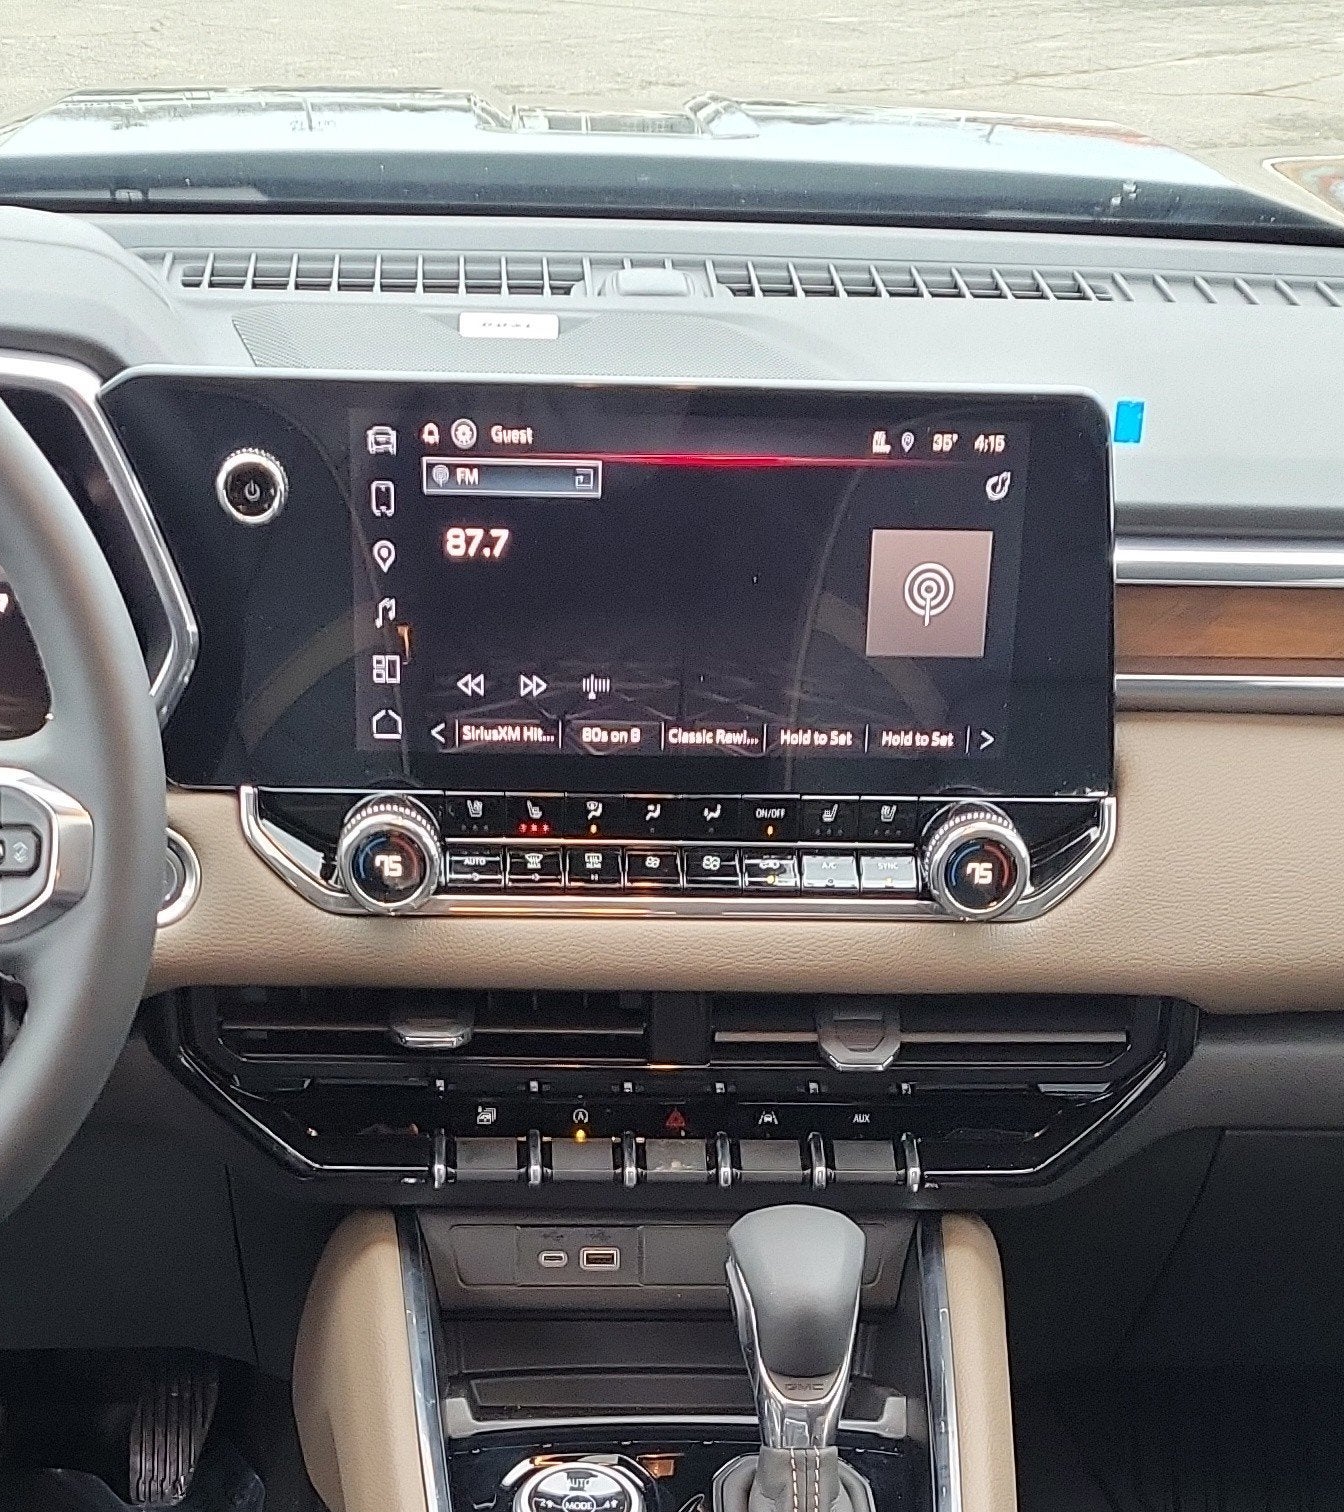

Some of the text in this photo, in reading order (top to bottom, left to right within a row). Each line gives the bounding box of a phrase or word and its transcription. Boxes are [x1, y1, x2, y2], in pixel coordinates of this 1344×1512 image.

[490, 425, 533, 445] Guest
[456, 467, 479, 486] FM
[446, 527, 510, 558] 87.7
[462, 725, 521, 742] SiriusXM
[612, 730, 628, 743] on
[668, 728, 714, 744] Classic
[780, 729, 853, 746] Hold to Set
[881, 730, 954, 747] Hold to Set
[755, 808, 786, 820] ON/OFF
[374, 854, 403, 877] 75
[463, 857, 486, 866] AUTO
[877, 862, 899, 870] SYNC
[966, 862, 993, 884] 75
[852, 1113, 870, 1123] AUX
